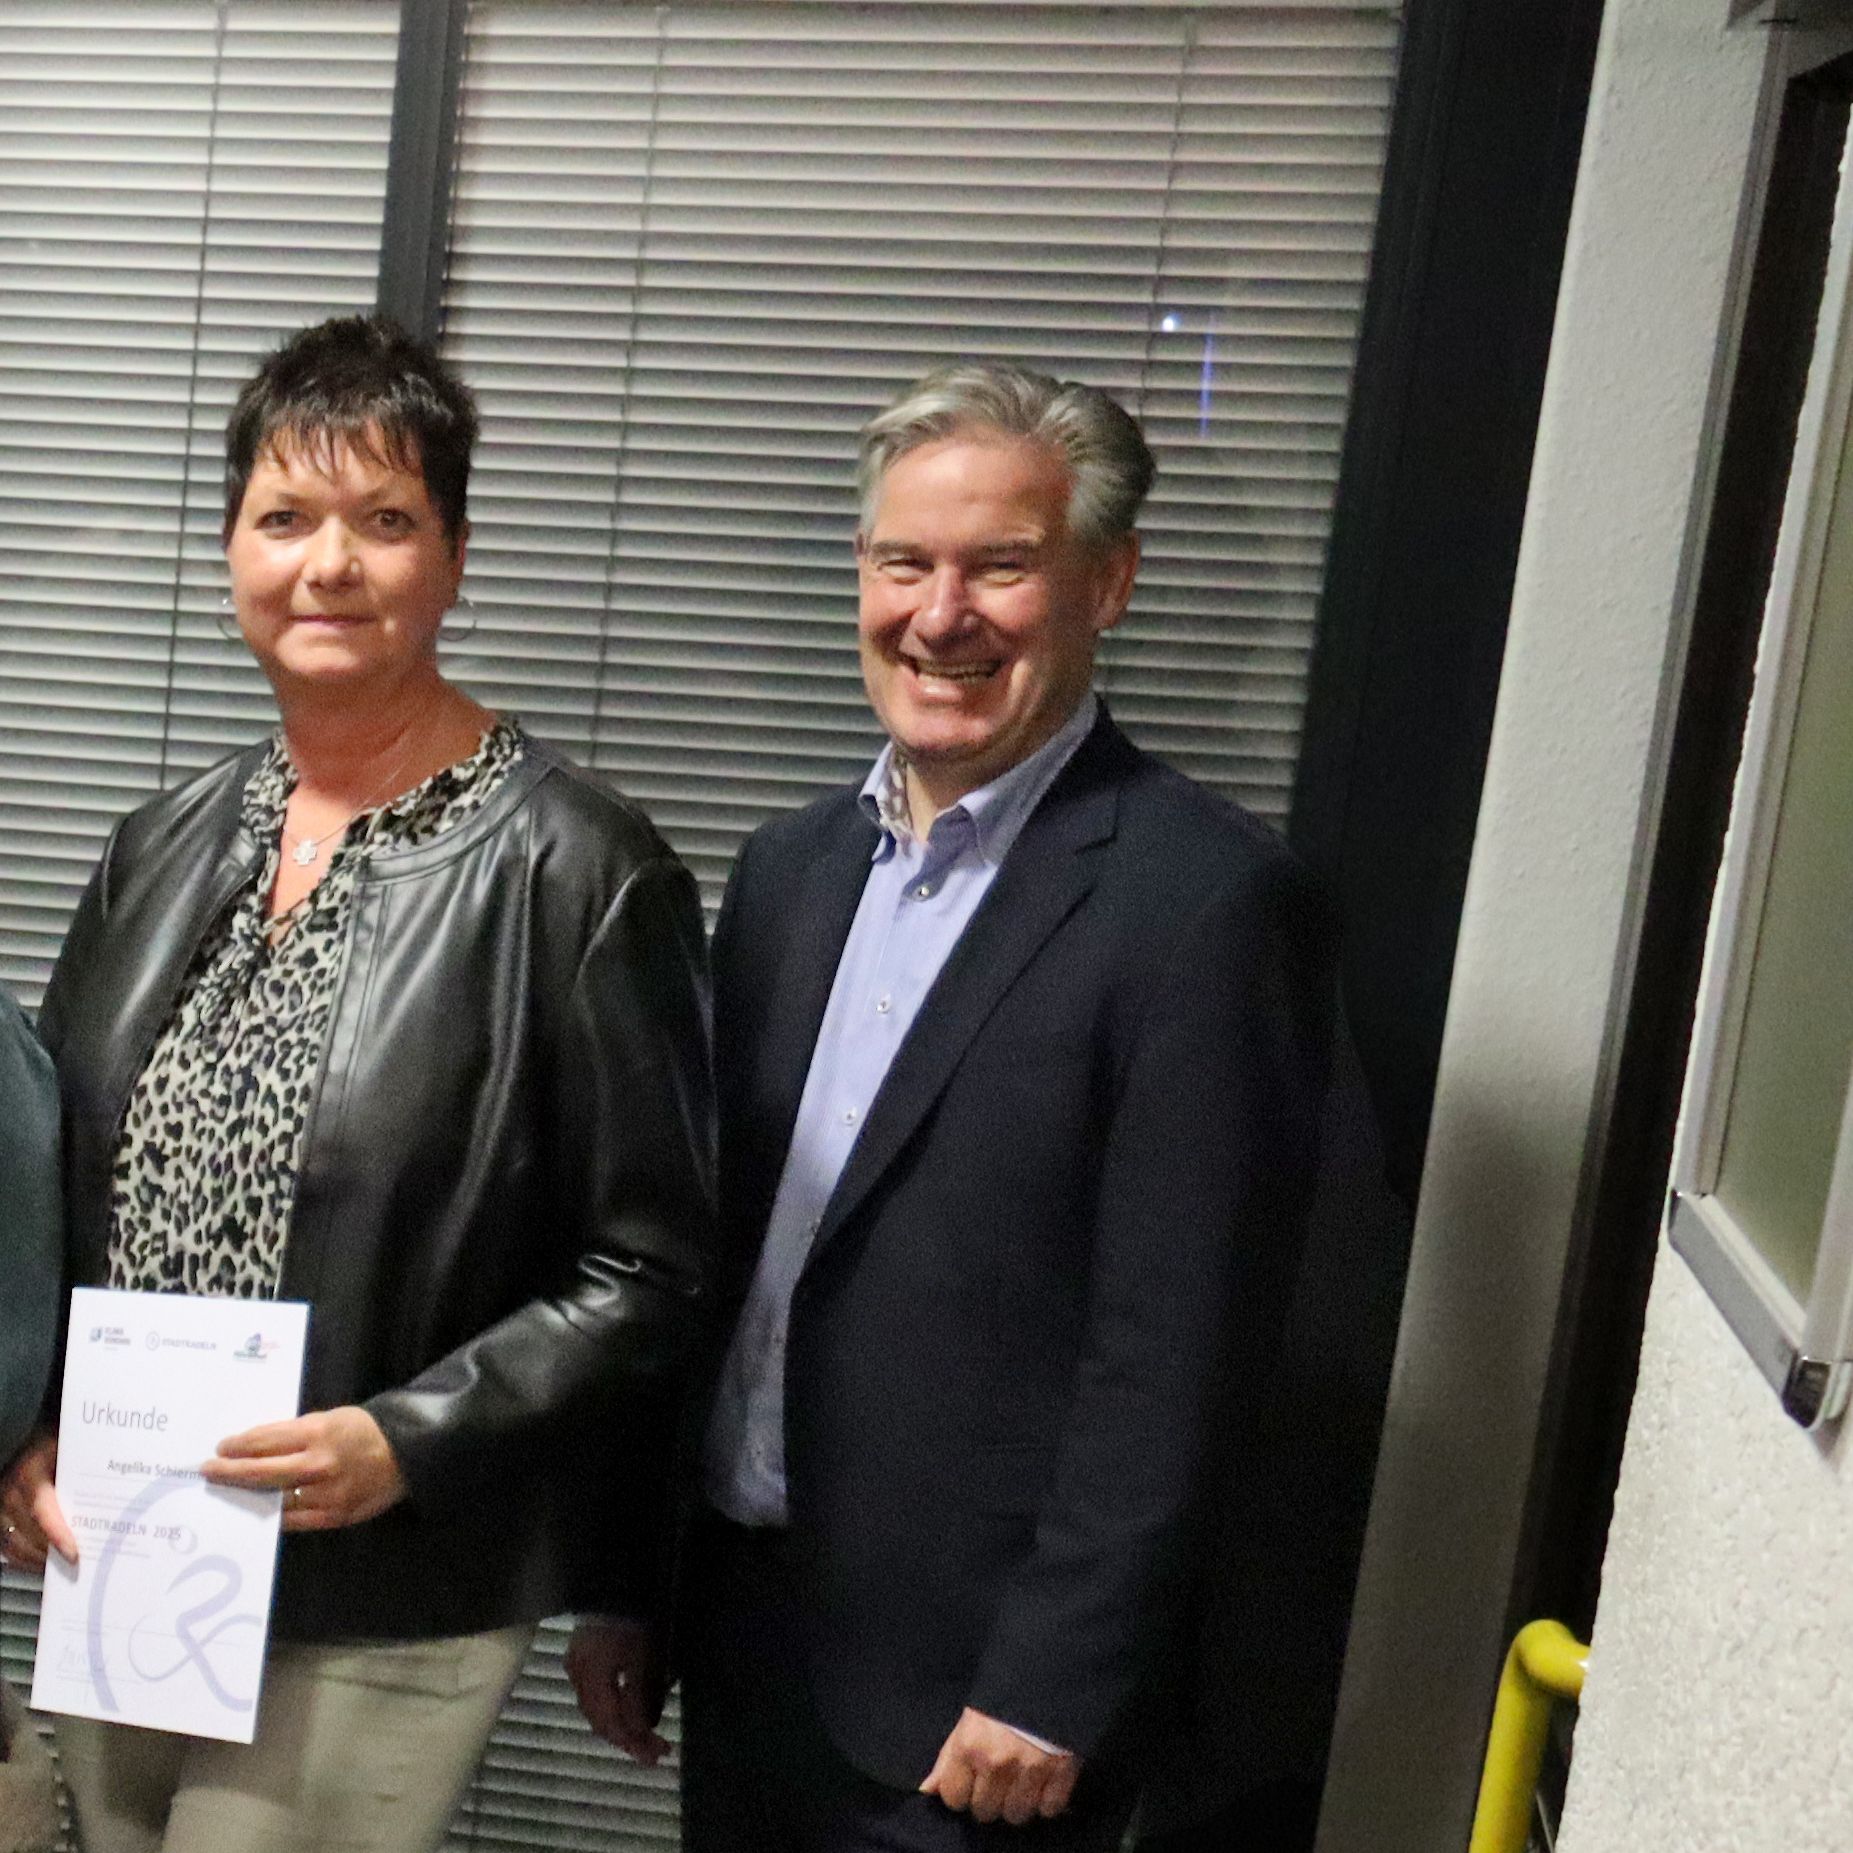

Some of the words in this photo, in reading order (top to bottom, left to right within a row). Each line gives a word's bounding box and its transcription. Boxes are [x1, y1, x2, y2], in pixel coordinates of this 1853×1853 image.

[82, 1401, 168, 1431] Urkunde
[107, 1459, 151, 1475] Angelika
[72, 1516, 147, 1536] STADTRADELN
[154, 1526, 181, 1541] 2025
